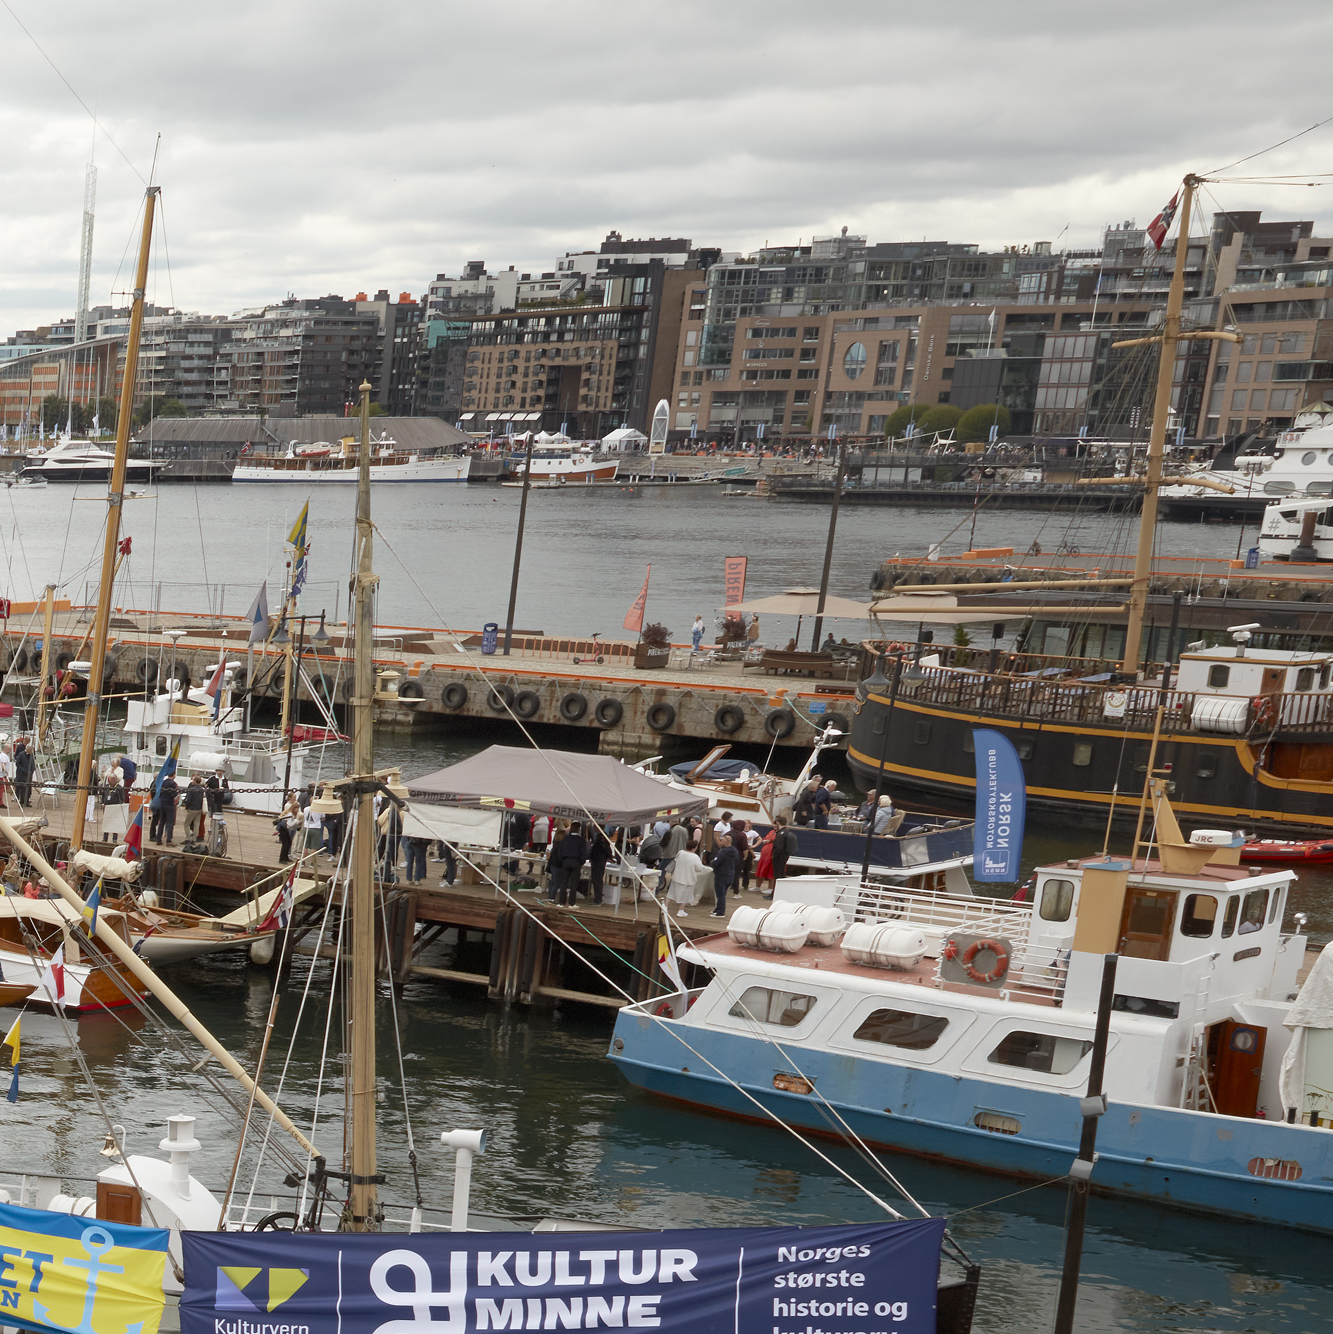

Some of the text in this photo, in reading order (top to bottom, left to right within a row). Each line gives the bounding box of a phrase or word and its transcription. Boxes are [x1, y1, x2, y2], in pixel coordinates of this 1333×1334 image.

[924, 355, 932, 381] Danske
[1194, 835, 1214, 843] JRC
[777, 1244, 871, 1263] Norges
[476, 1249, 699, 1287] KULTUR
[773, 1269, 866, 1289] største
[474, 1295, 662, 1330] MINNE
[772, 1296, 908, 1321] historie og
